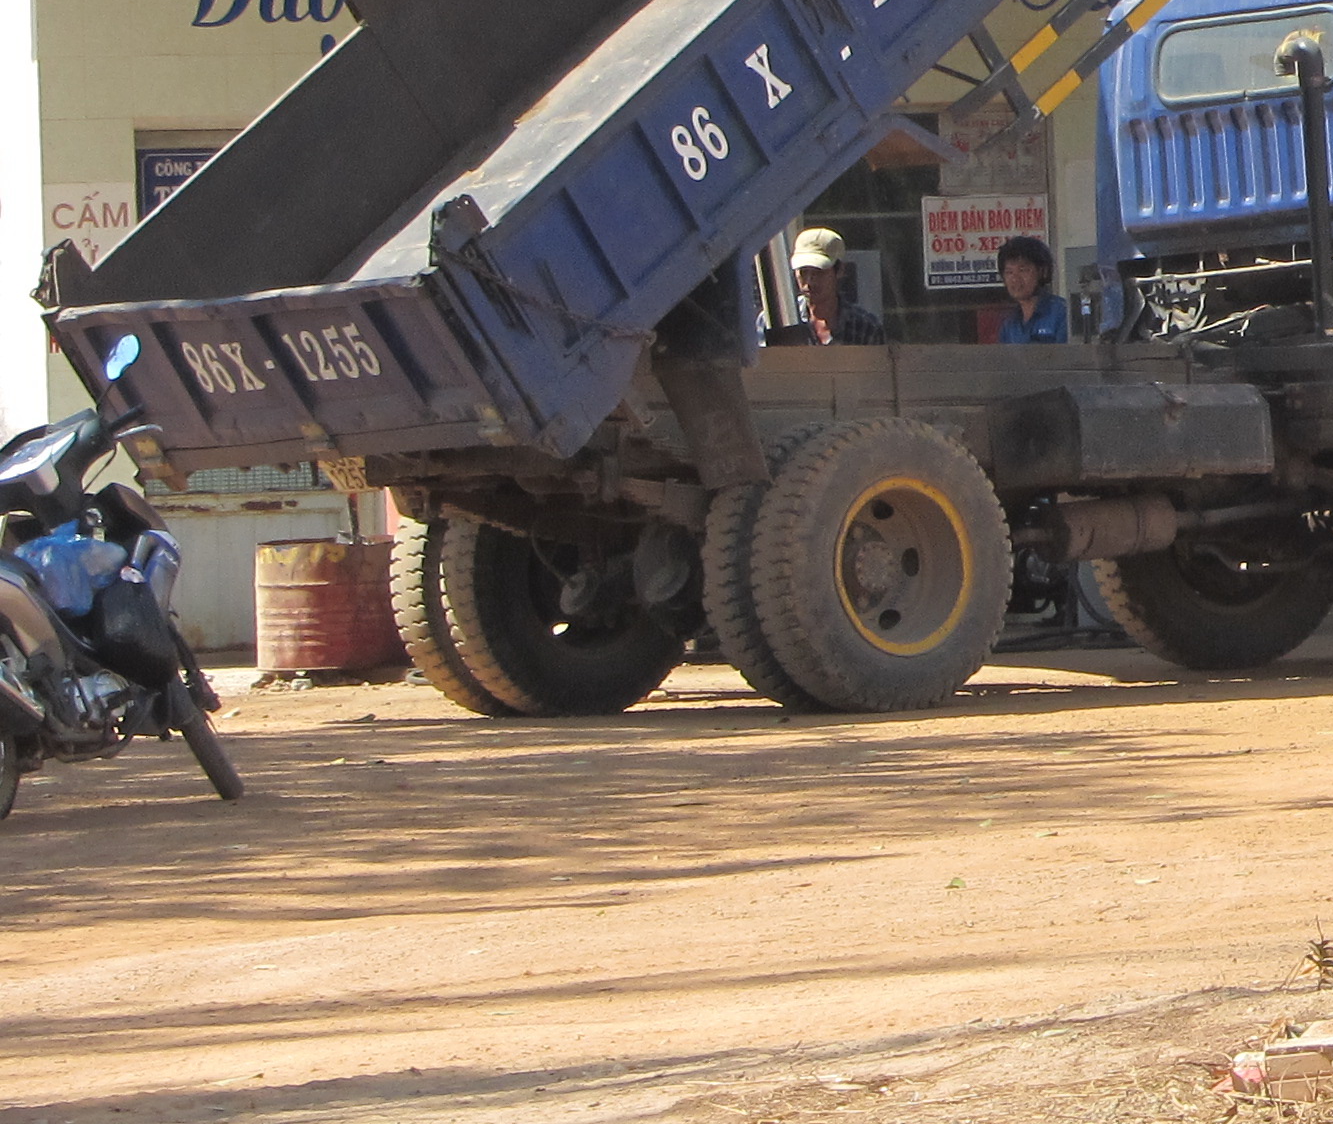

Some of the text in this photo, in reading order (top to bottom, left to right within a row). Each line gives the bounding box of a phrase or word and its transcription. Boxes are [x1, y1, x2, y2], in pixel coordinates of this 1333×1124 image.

[671, 106, 731, 181] 86
[745, 44, 793, 109] X
[155, 158, 192, 176] CÔNG
[51, 191, 129, 229] CẤM
